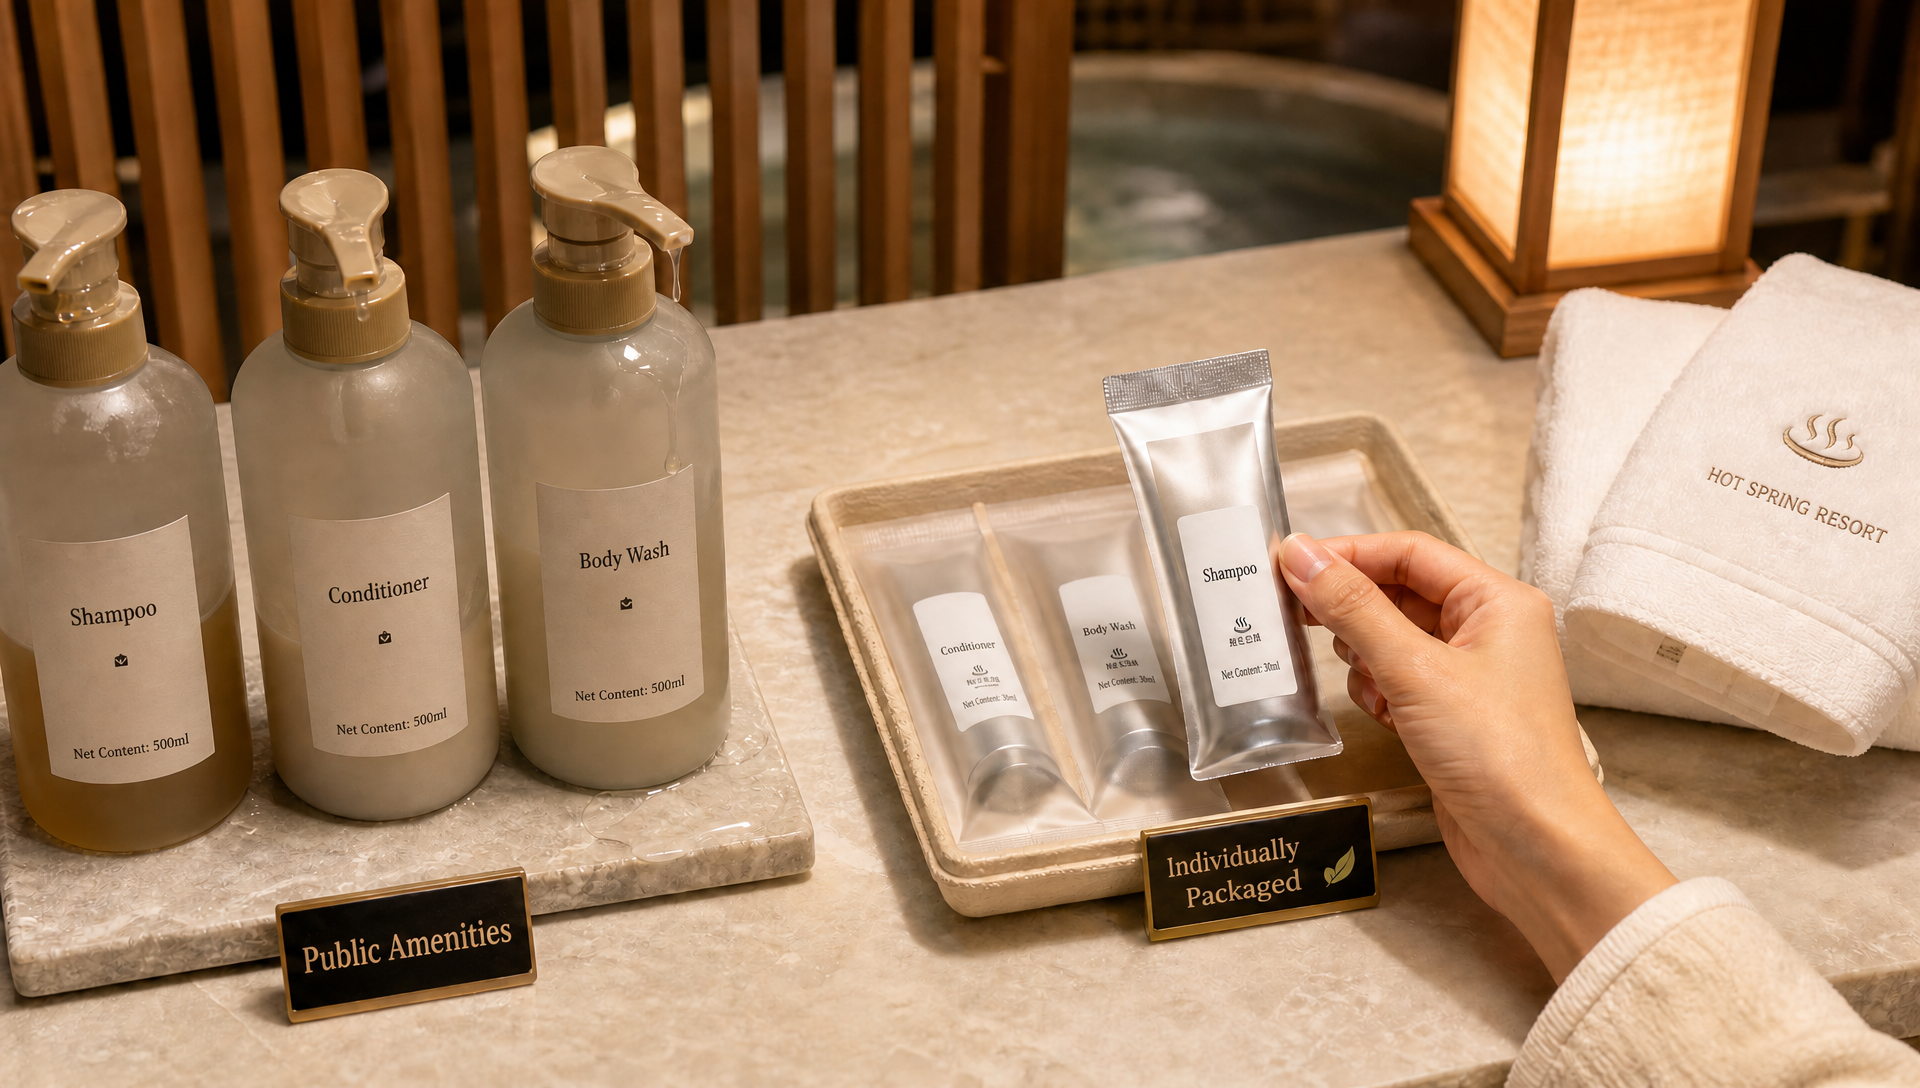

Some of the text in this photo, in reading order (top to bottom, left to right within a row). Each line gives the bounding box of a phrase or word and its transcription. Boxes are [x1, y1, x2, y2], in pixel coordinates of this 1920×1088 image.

[1707, 466, 1888, 544] HOT SPRING RESORT
[579, 540, 670, 571] Body Wash
[1202, 564, 1258, 583] Shampoo
[328, 576, 429, 604] Conditioner
[70, 603, 157, 627] Shampoo
[1082, 621, 1136, 636] Body Wash
[940, 641, 996, 656] Conditioner
[1098, 680, 1111, 691] Net
[1111, 677, 1138, 687] Content:
[1221, 670, 1234, 680] Net
[1234, 664, 1263, 678] Content:
[575, 674, 685, 702] Net Content: 500ml
[962, 700, 975, 710] Net
[975, 696, 1001, 706] Content:
[336, 707, 447, 735] Net Content: 500ml
[73, 732, 189, 760] Net Content: 500ml
[1167, 837, 1300, 878] Individually
[1186, 868, 1302, 909] Packaged
[302, 919, 512, 974] Public Amenities
